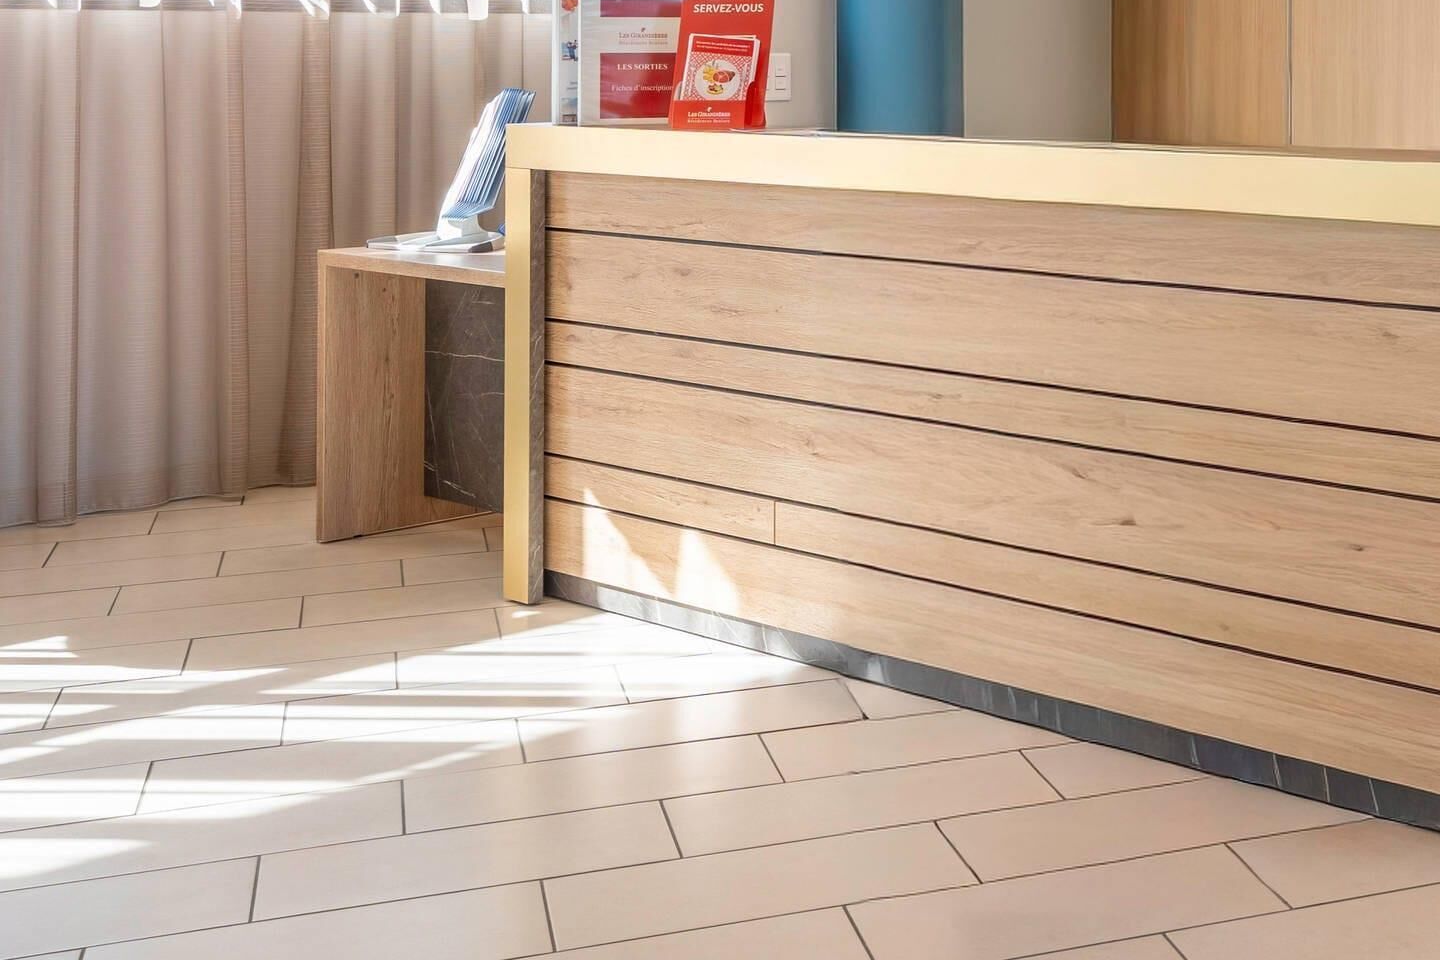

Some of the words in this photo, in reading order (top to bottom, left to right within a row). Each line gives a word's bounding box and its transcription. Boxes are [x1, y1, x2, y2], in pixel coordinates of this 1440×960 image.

[693, 3, 764, 13] SERVEZ-VOUS
[617, 63, 633, 71] LES
[634, 63, 668, 71] SORTIES
[611, 84, 632, 92] Fiches
